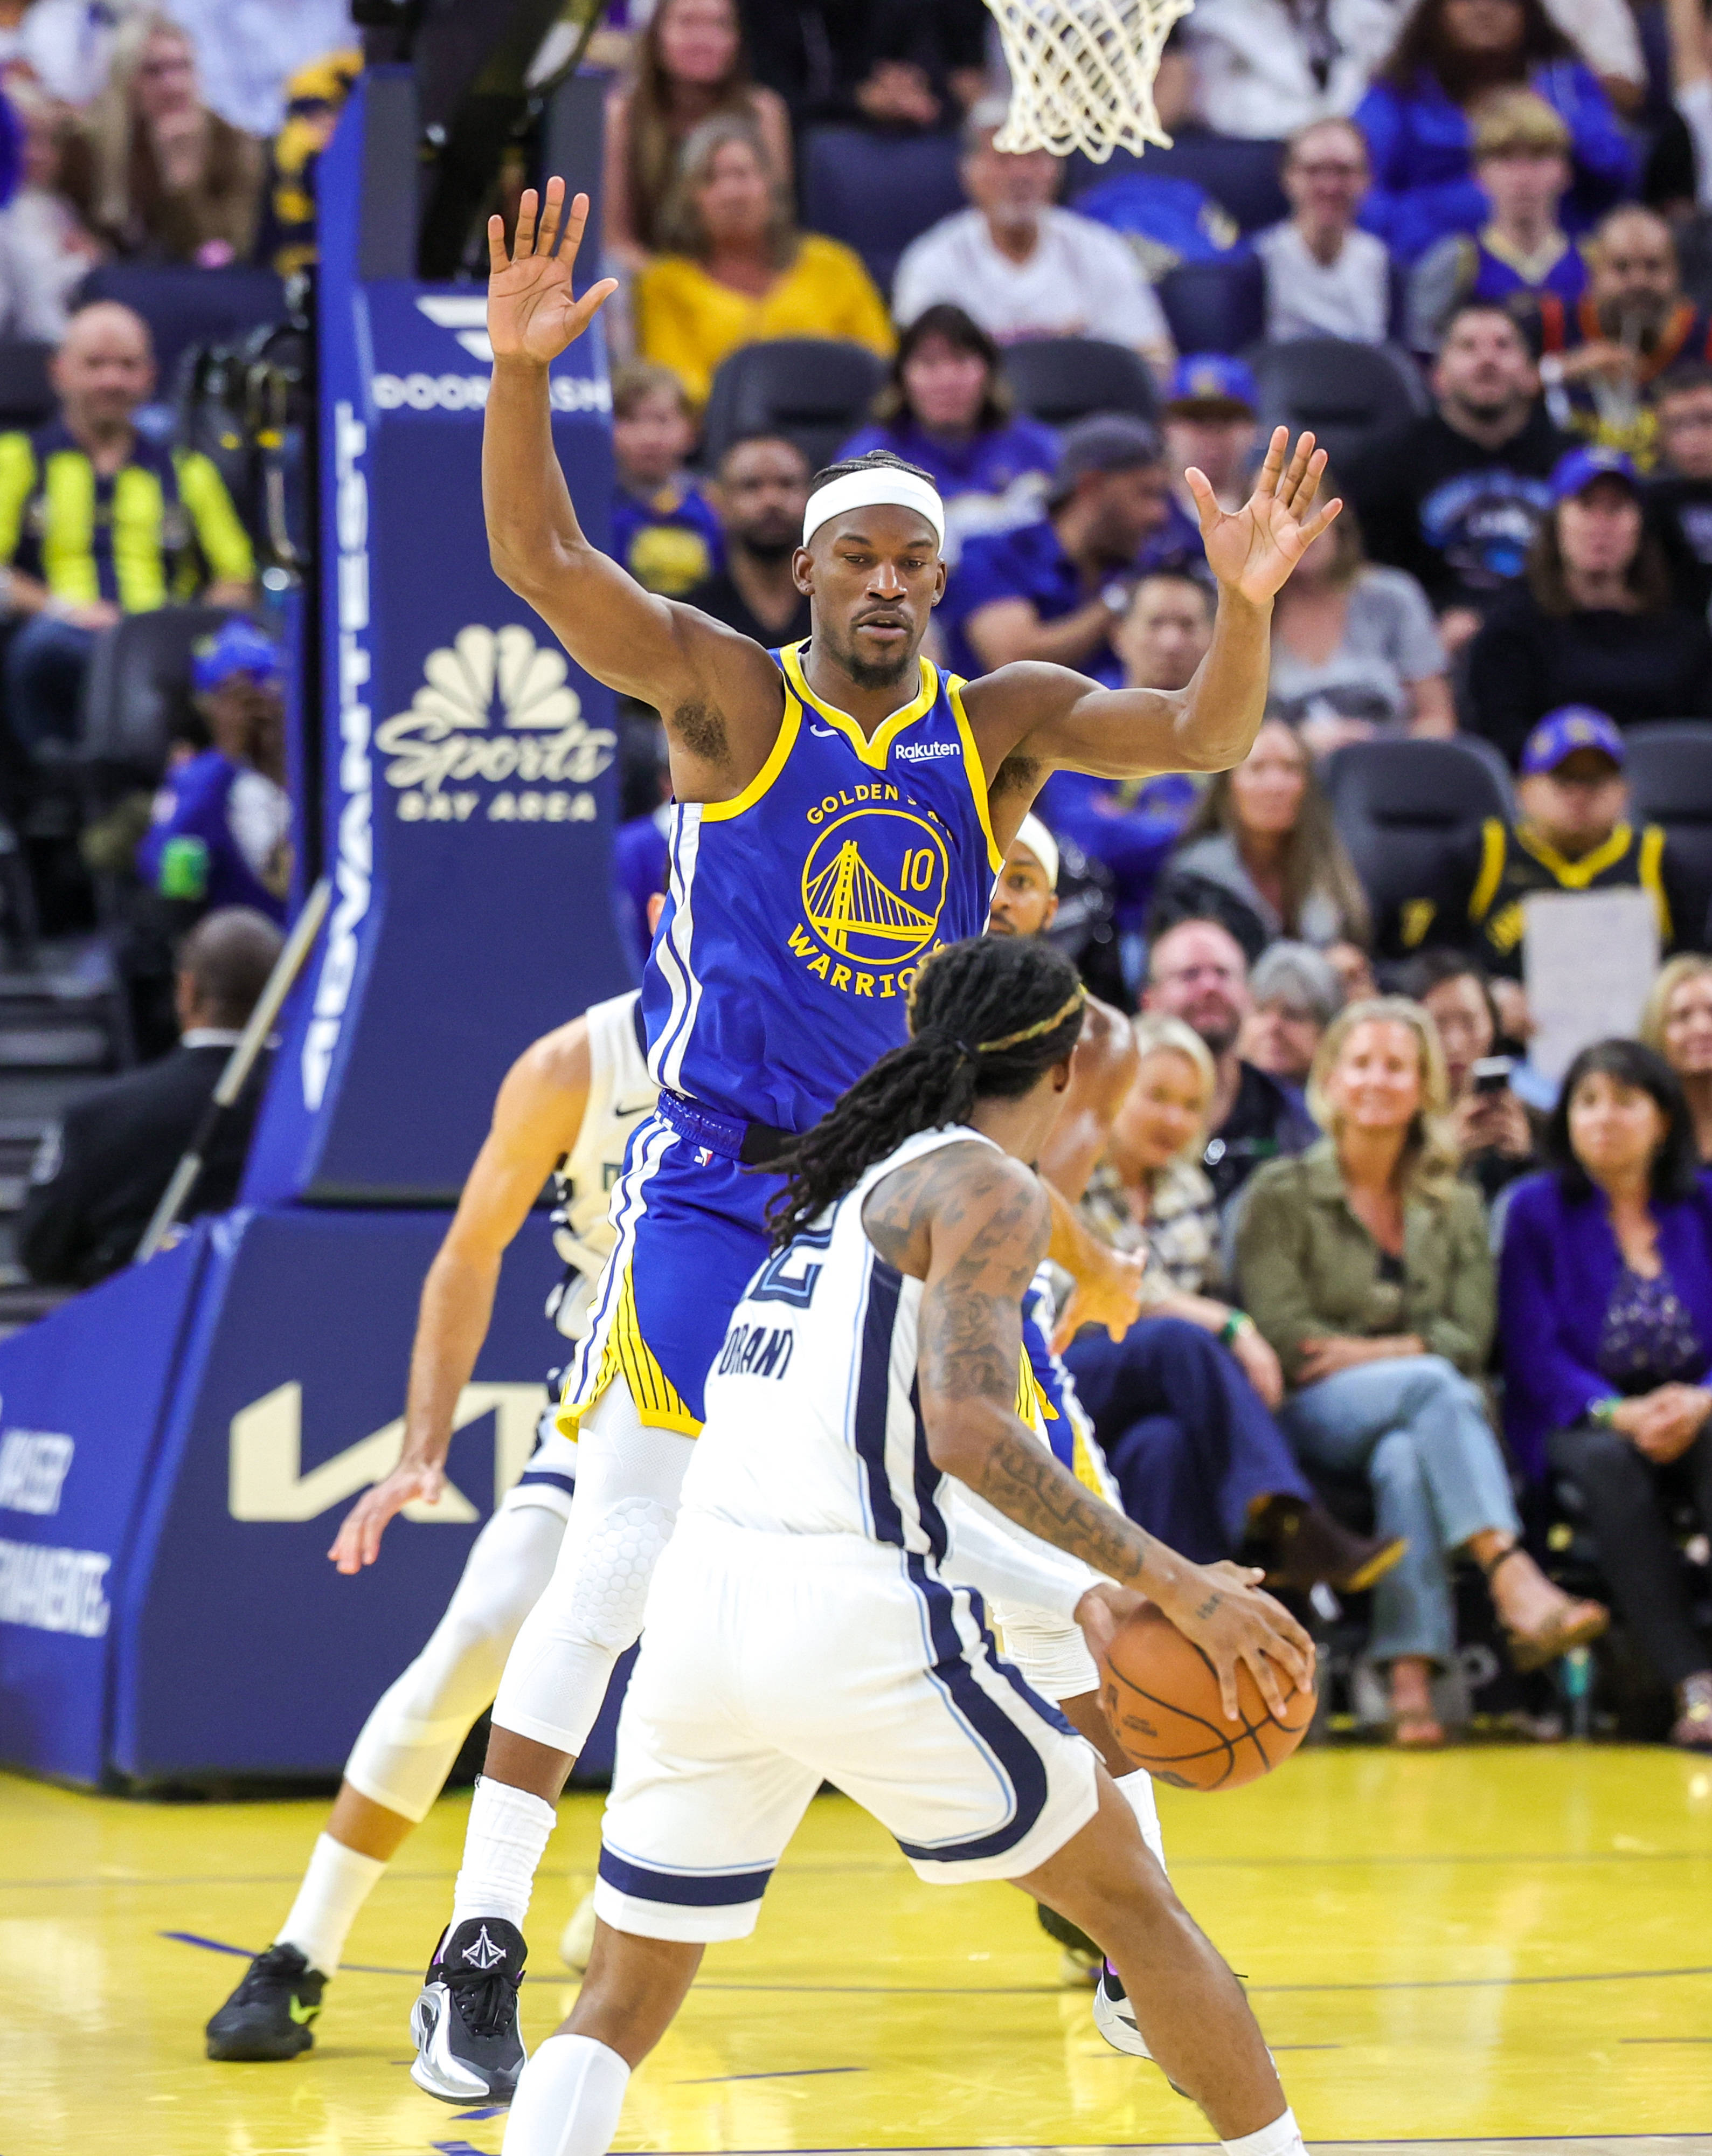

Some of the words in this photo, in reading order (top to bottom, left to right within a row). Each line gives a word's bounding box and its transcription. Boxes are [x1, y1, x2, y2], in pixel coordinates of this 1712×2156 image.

[375, 713, 618, 792] Sports
[895, 741, 961, 761] Rakuten
[396, 791, 479, 822] BAY
[487, 791, 597, 822] AREA
[806, 783, 899, 825] GOLDEN
[900, 848, 935, 892] 10
